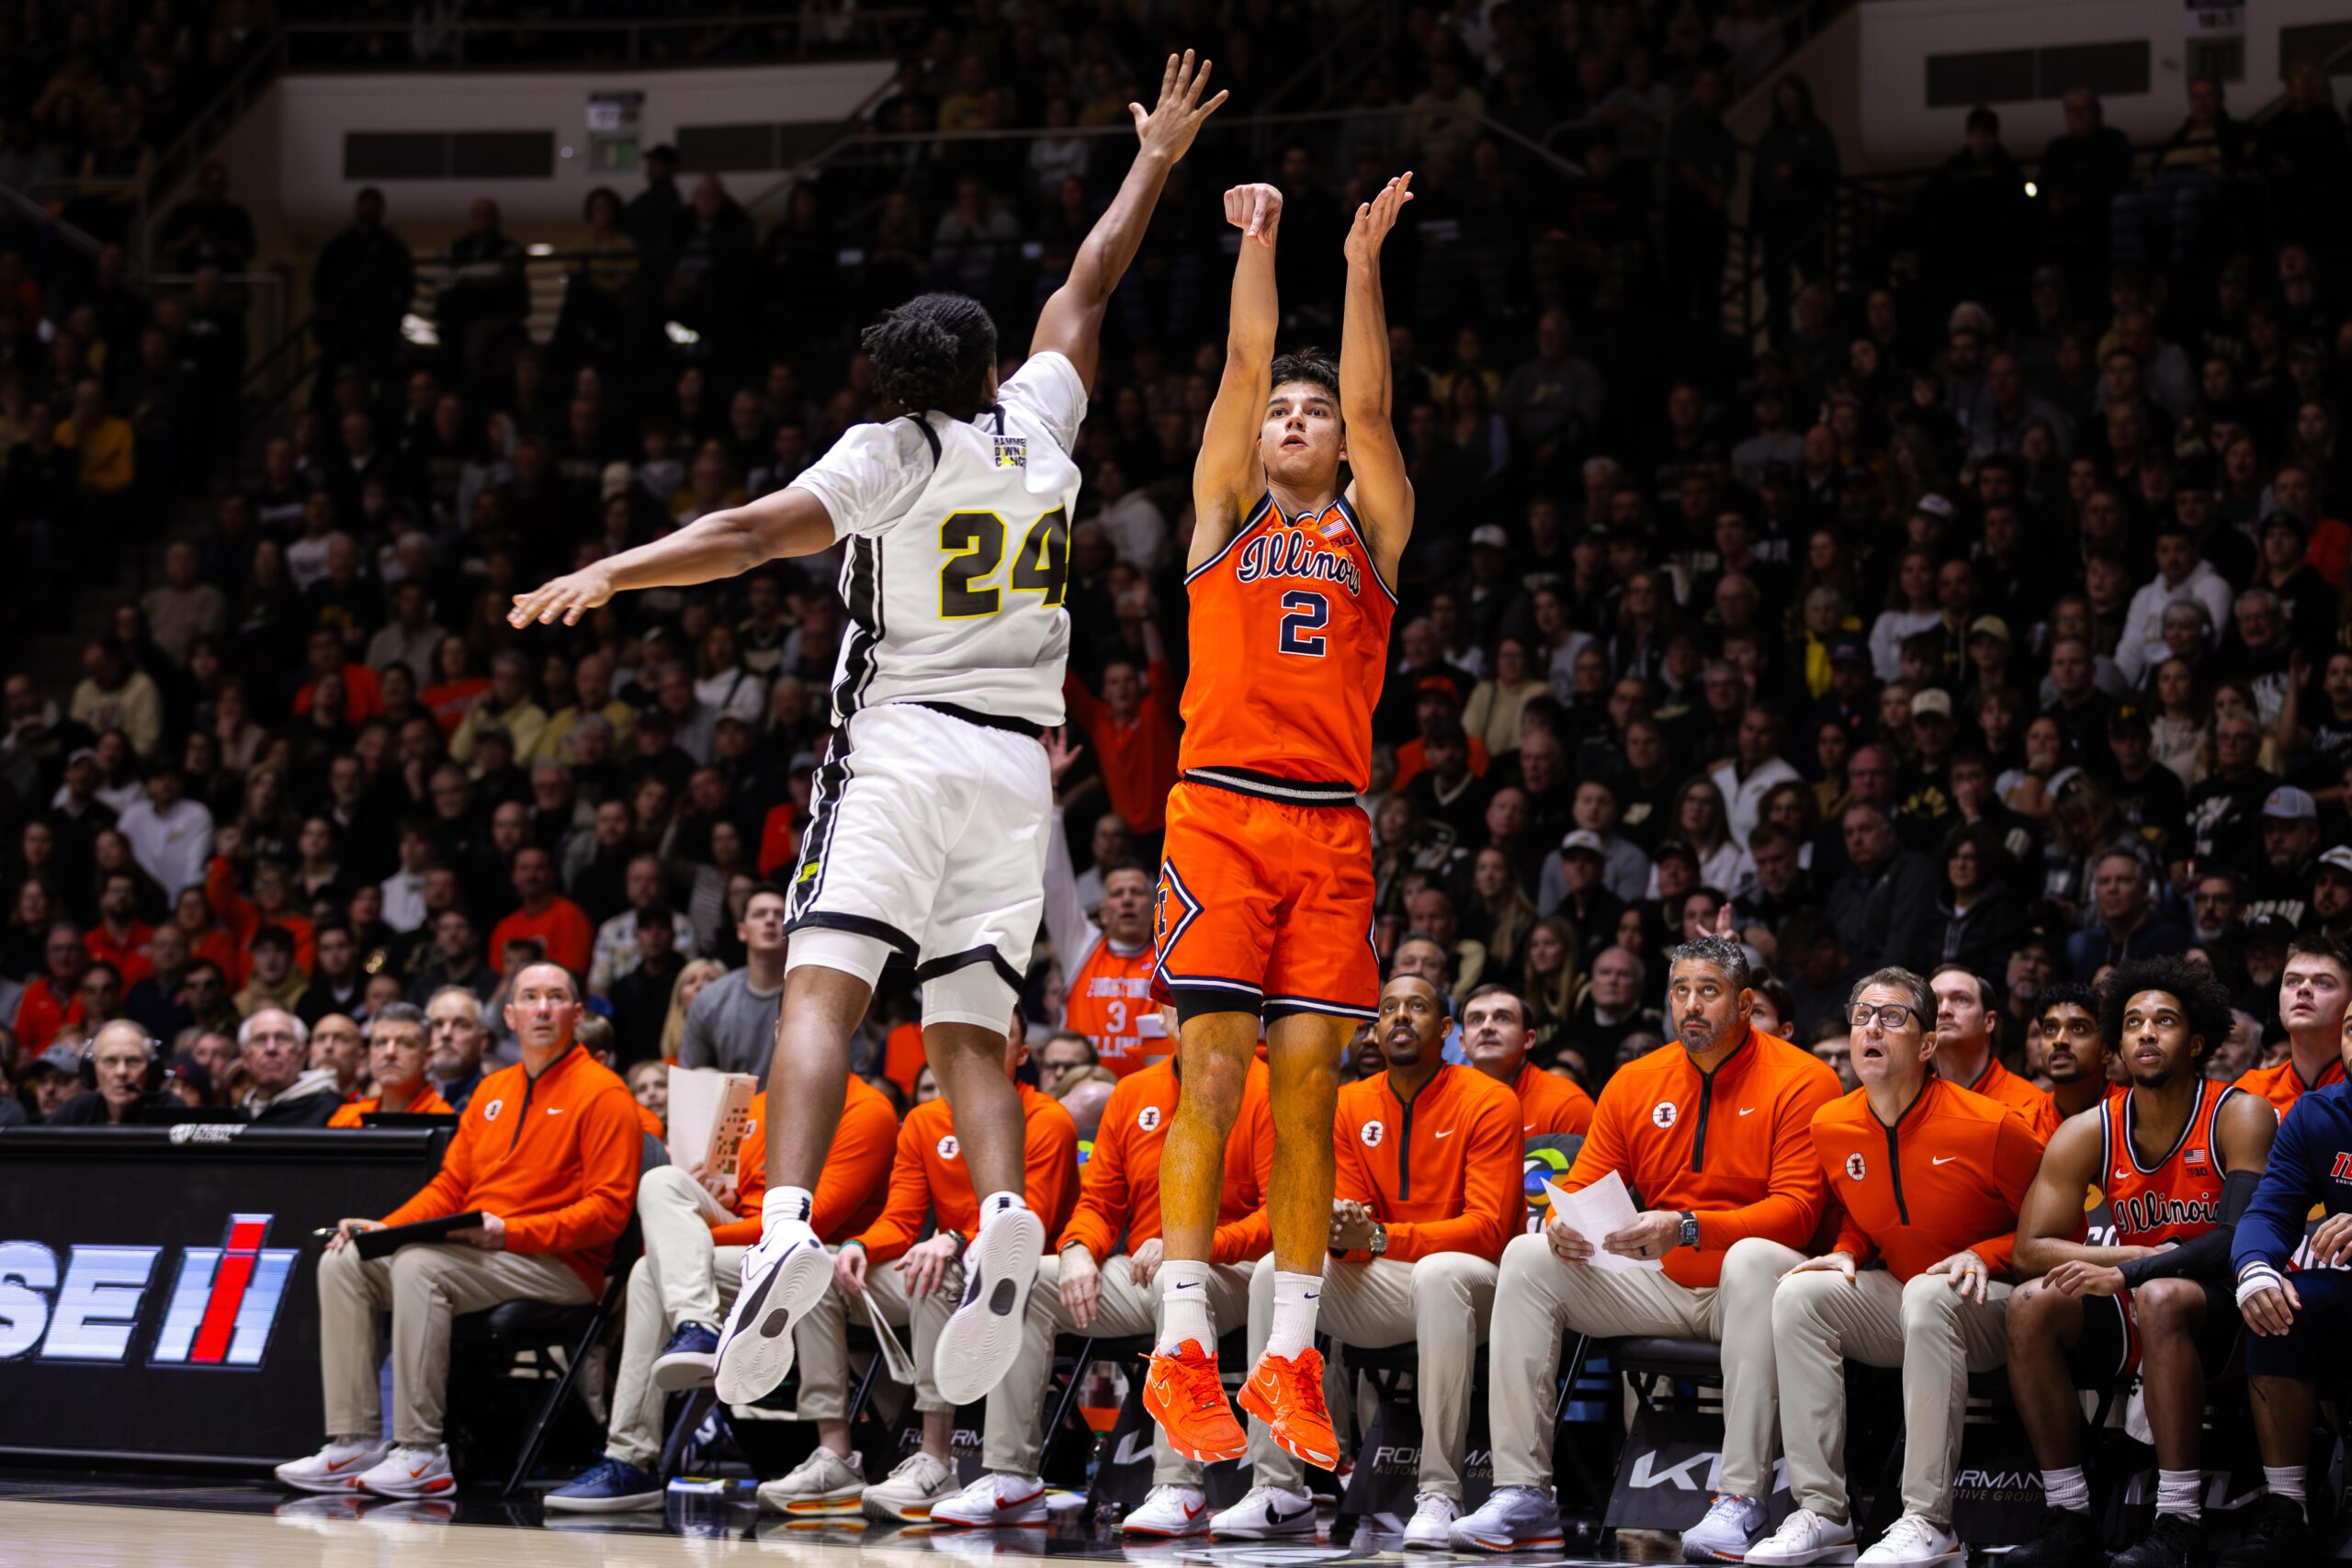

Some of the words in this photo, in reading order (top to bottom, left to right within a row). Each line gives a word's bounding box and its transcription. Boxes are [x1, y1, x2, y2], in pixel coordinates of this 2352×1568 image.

[938, 504, 1071, 620] 24
[1237, 529, 1361, 597] Illinois
[1278, 589, 1329, 658] 2
[1105, 999, 1127, 1034] 3
[1993, 1490, 2042, 1503] GROUP
